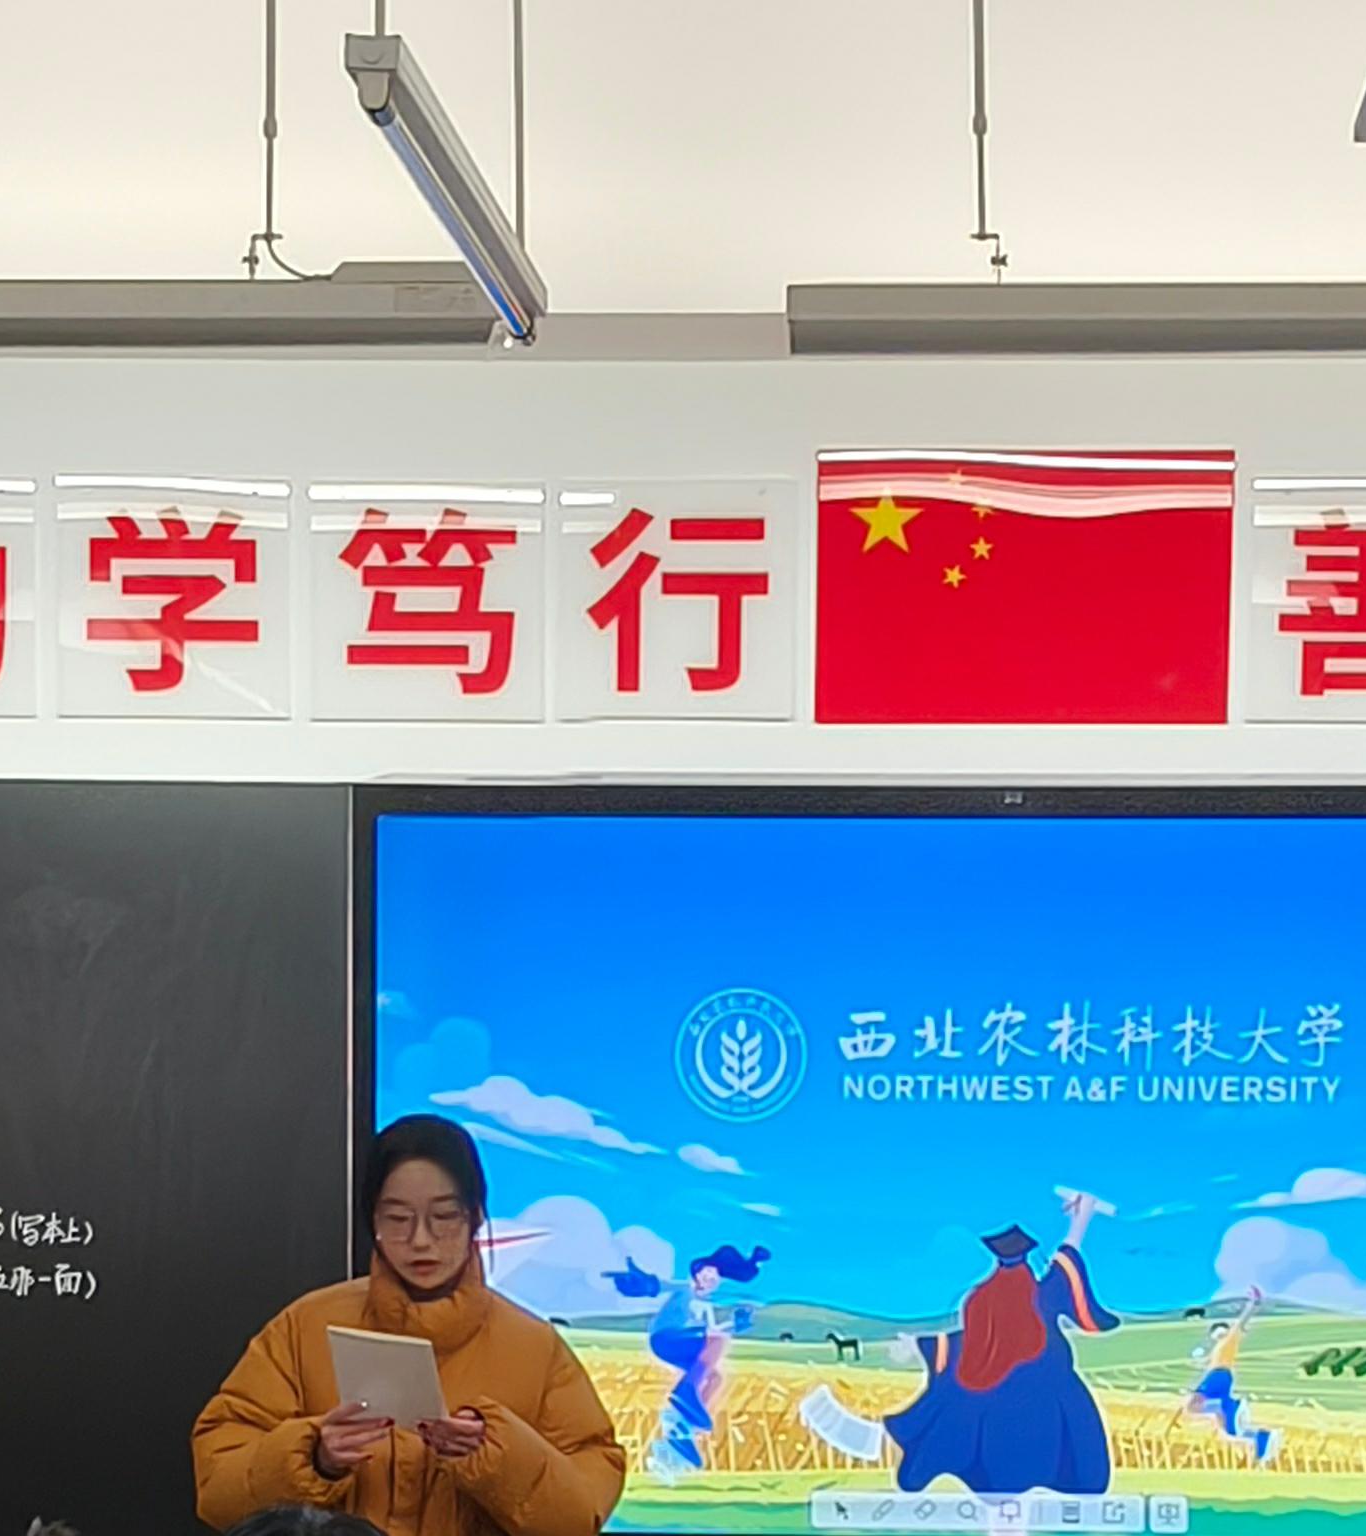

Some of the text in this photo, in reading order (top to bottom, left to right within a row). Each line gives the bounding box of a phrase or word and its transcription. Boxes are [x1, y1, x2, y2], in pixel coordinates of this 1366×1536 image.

[838, 1000, 1344, 1072] 西北农林科技大学
[843, 1073, 1342, 1103] NORTHWEST A&F UNIVERSITY
